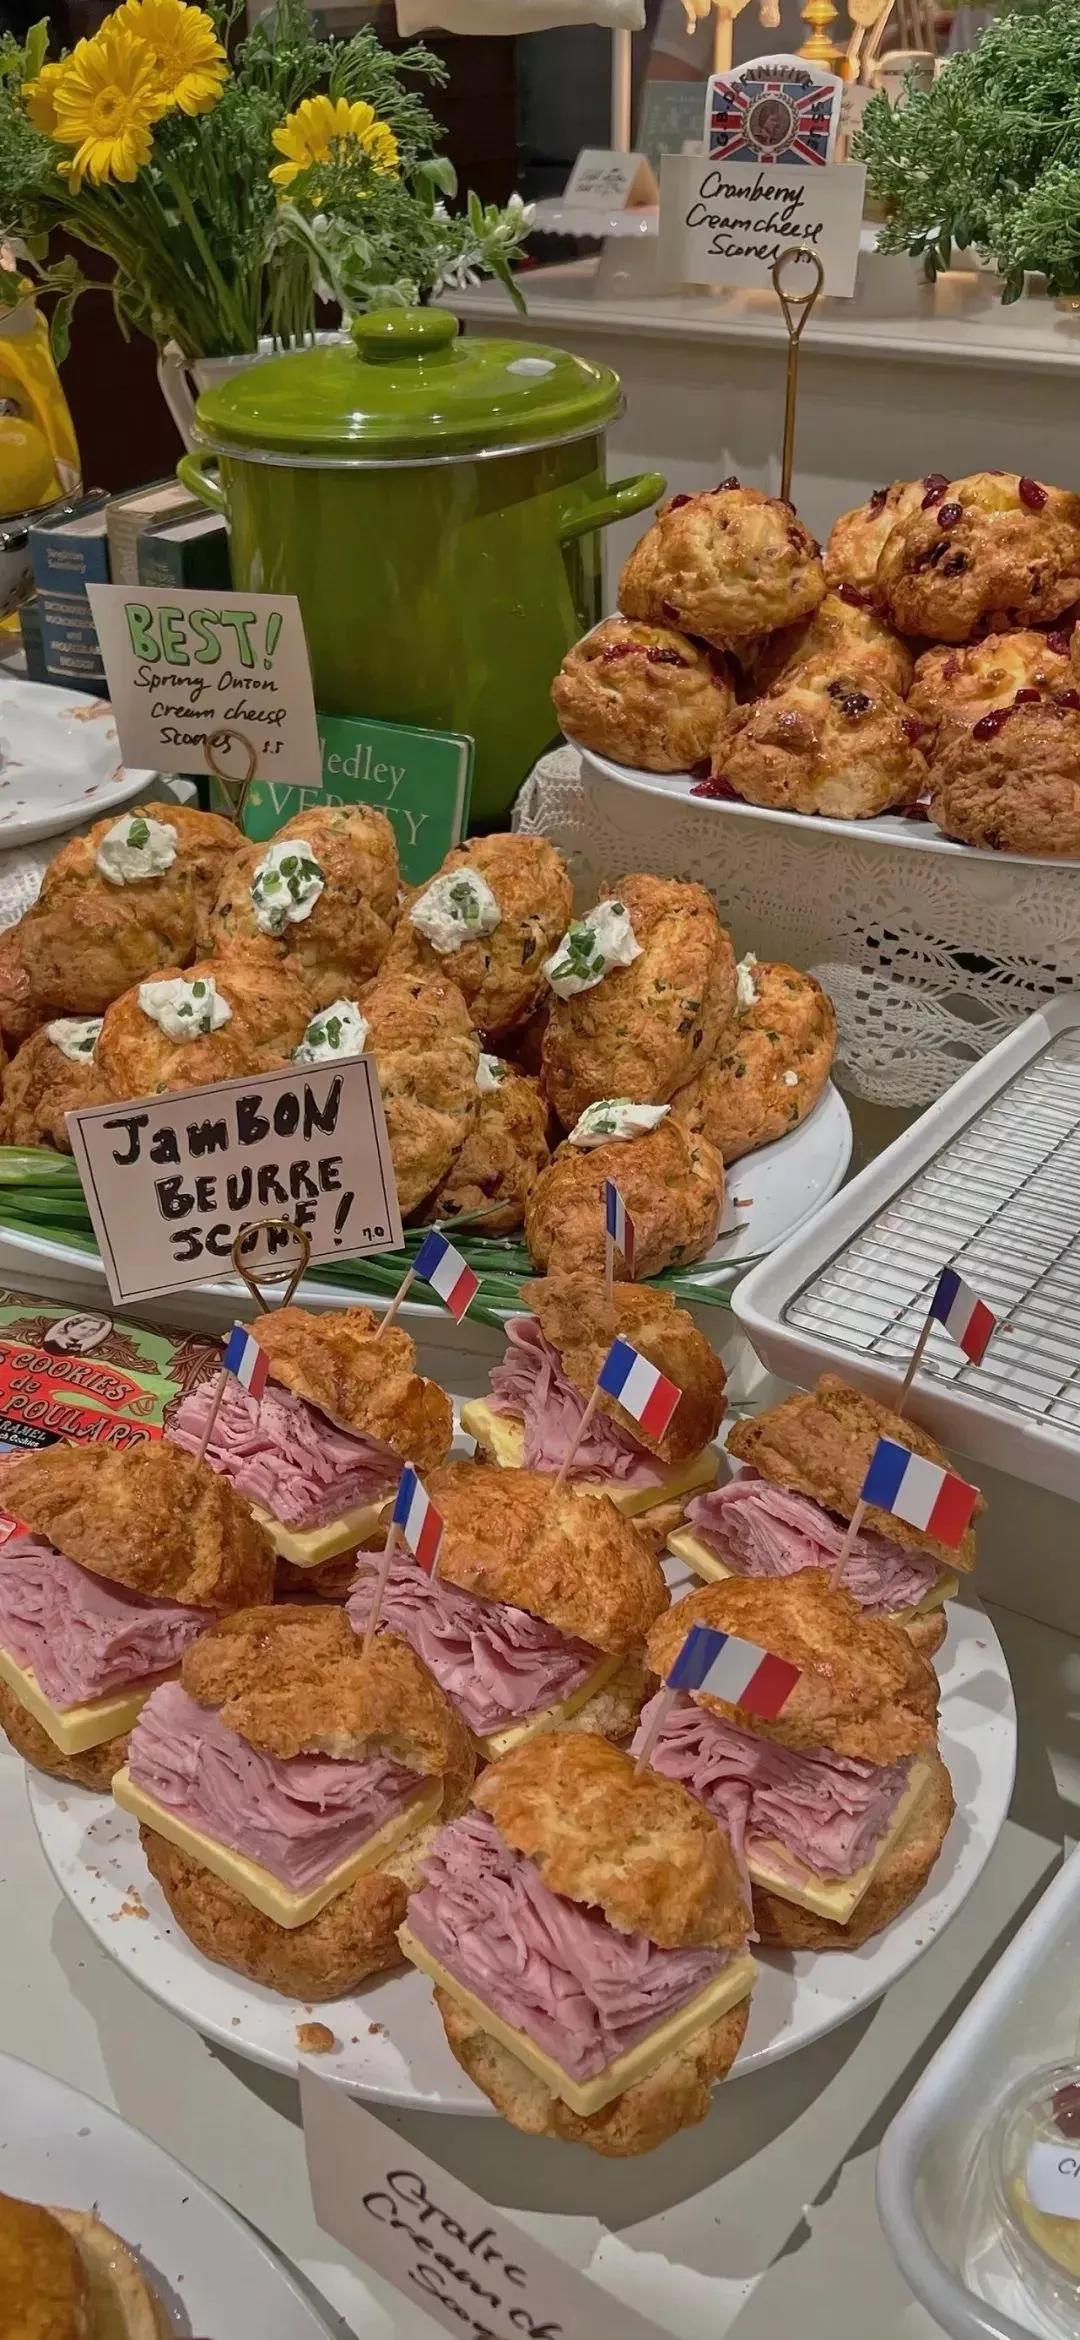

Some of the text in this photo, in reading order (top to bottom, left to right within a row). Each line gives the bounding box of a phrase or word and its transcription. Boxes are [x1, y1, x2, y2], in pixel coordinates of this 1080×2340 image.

[699, 170, 806, 222] Cranberry
[124, 602, 283, 671] BEST!
[320, 739, 406, 800] edley
[154, 1156, 343, 1222] BEURRE
[9, 1375, 41, 1393] de
[10, 1351, 136, 1402] COOKIES
